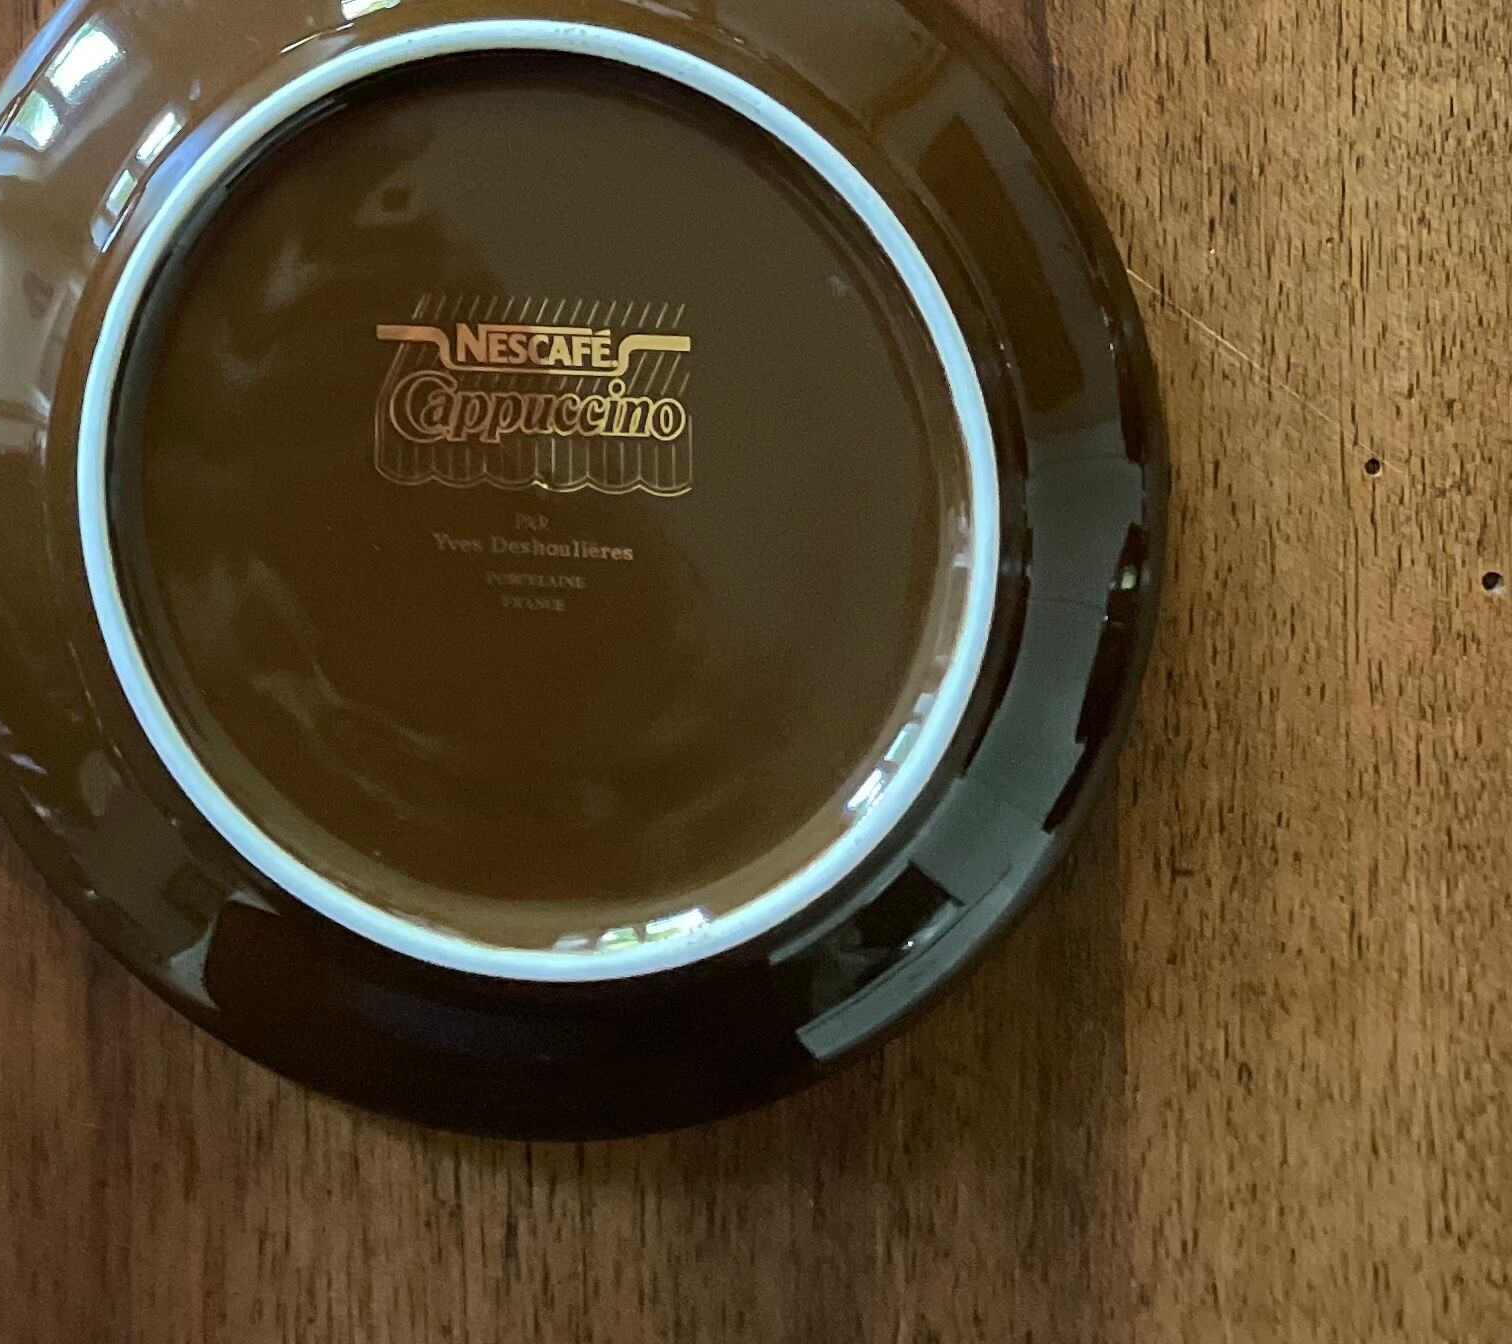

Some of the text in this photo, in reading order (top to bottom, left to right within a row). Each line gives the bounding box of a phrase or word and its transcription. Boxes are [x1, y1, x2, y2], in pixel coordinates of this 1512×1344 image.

[456, 323, 612, 369] NESCAFÉ
[390, 370, 686, 443] Cappuccino
[432, 532, 483, 553] Yves
